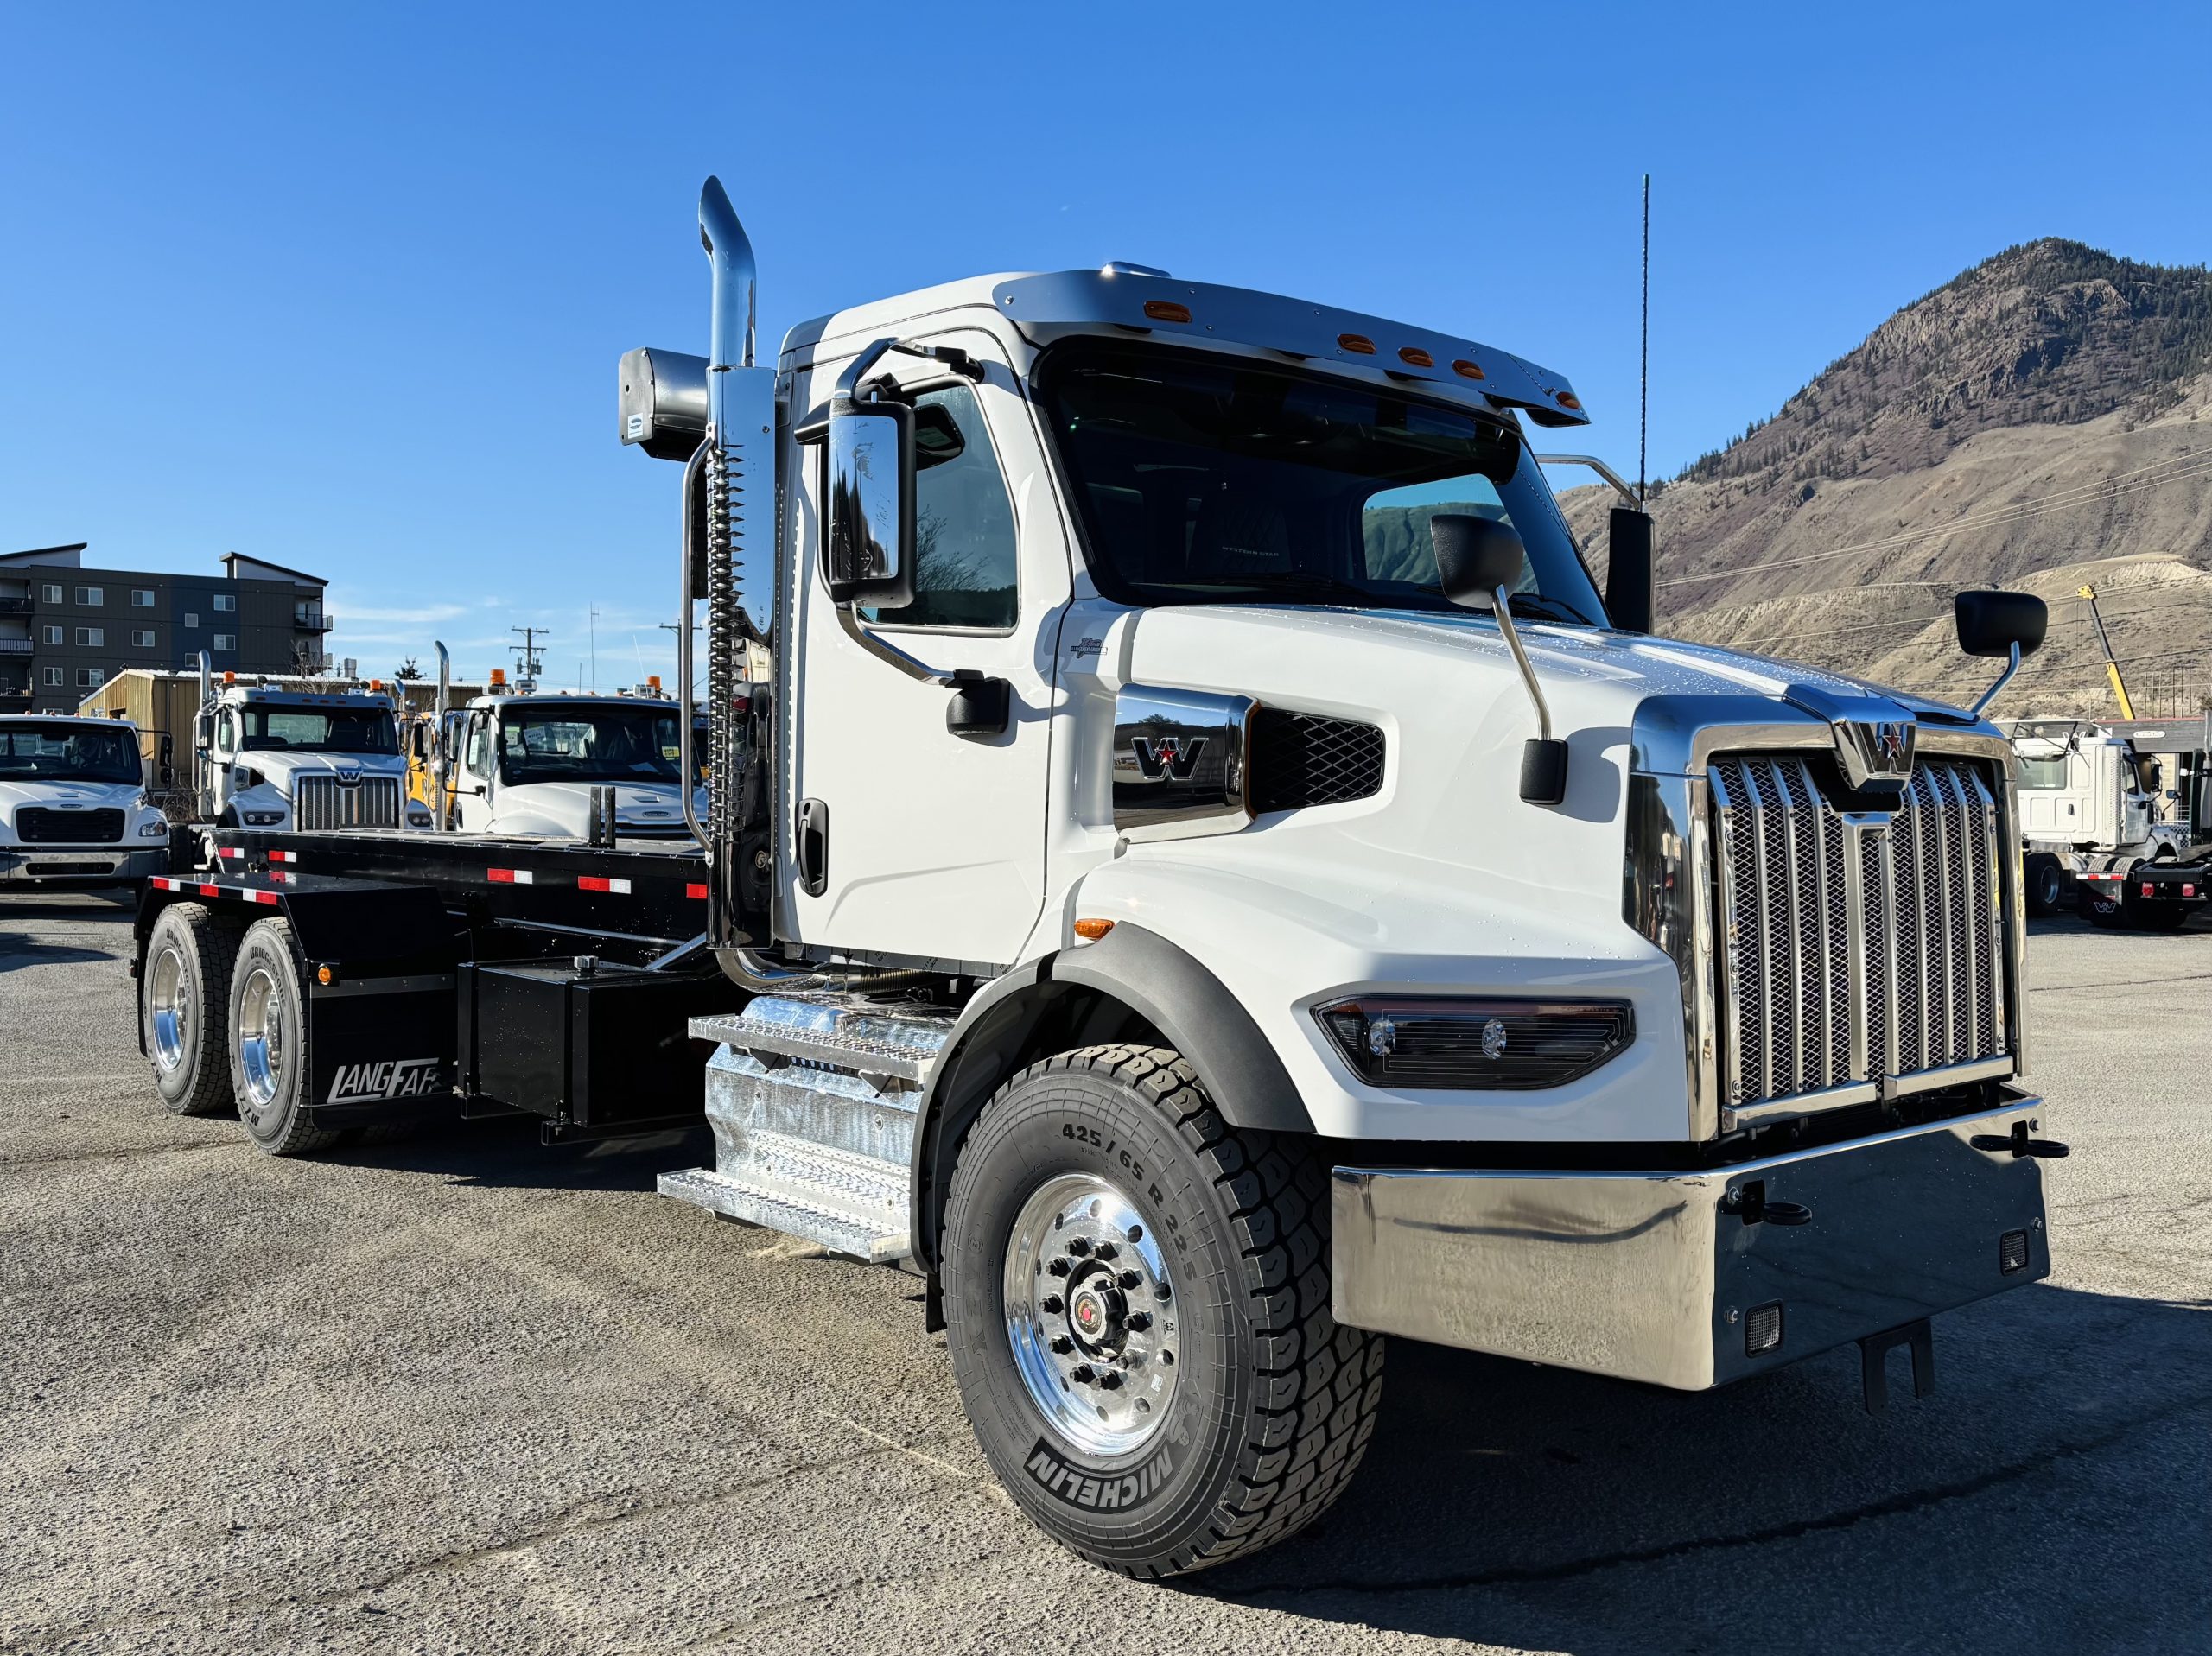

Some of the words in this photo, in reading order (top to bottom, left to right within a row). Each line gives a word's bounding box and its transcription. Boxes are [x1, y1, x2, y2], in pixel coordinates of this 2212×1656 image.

[250, 946, 286, 1007] BRIDGESTONE
[1147, 1182, 1164, 1209] R
[1166, 1214, 1198, 1281] 22.5
[1027, 1444, 1173, 1508] MICHELIN
